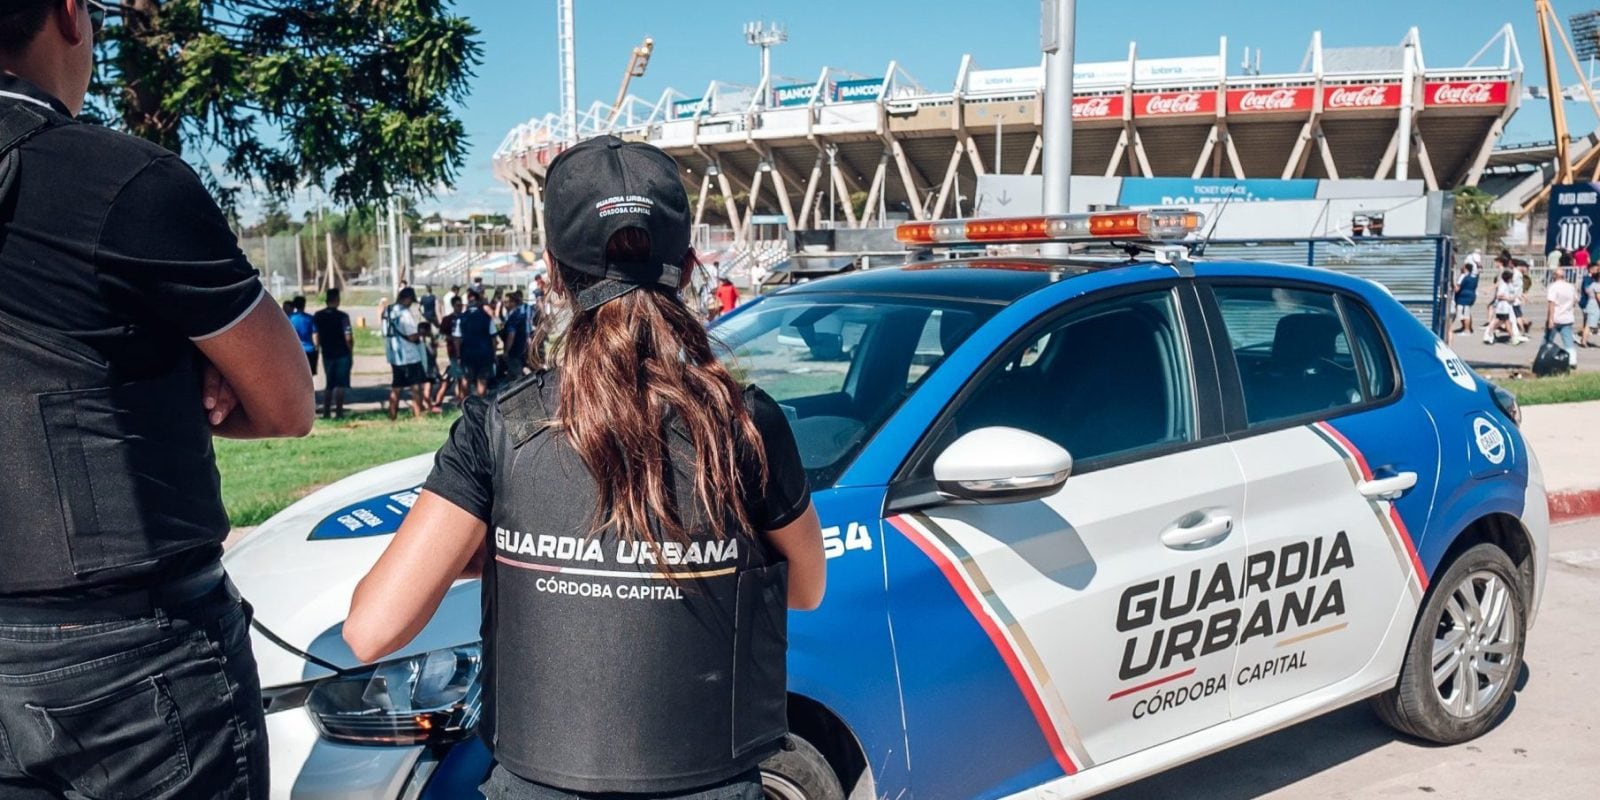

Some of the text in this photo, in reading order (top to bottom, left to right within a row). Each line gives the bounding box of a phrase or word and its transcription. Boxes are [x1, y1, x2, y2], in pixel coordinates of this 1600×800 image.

[596, 195, 655, 209] GUARDIA URBANA
[1194, 186, 1219, 194] TICKET
[629, 207, 651, 216] CAPITAL
[495, 526, 738, 565] GUARDIA URBANA
[822, 521, 872, 560] 54
[536, 576, 684, 600] CÓRDOBA CAPITAL
[1116, 530, 1354, 633] GUARDIA
[1118, 578, 1345, 681] URBANA
[1132, 650, 1307, 719] CÓRDOBA CAPITAL
